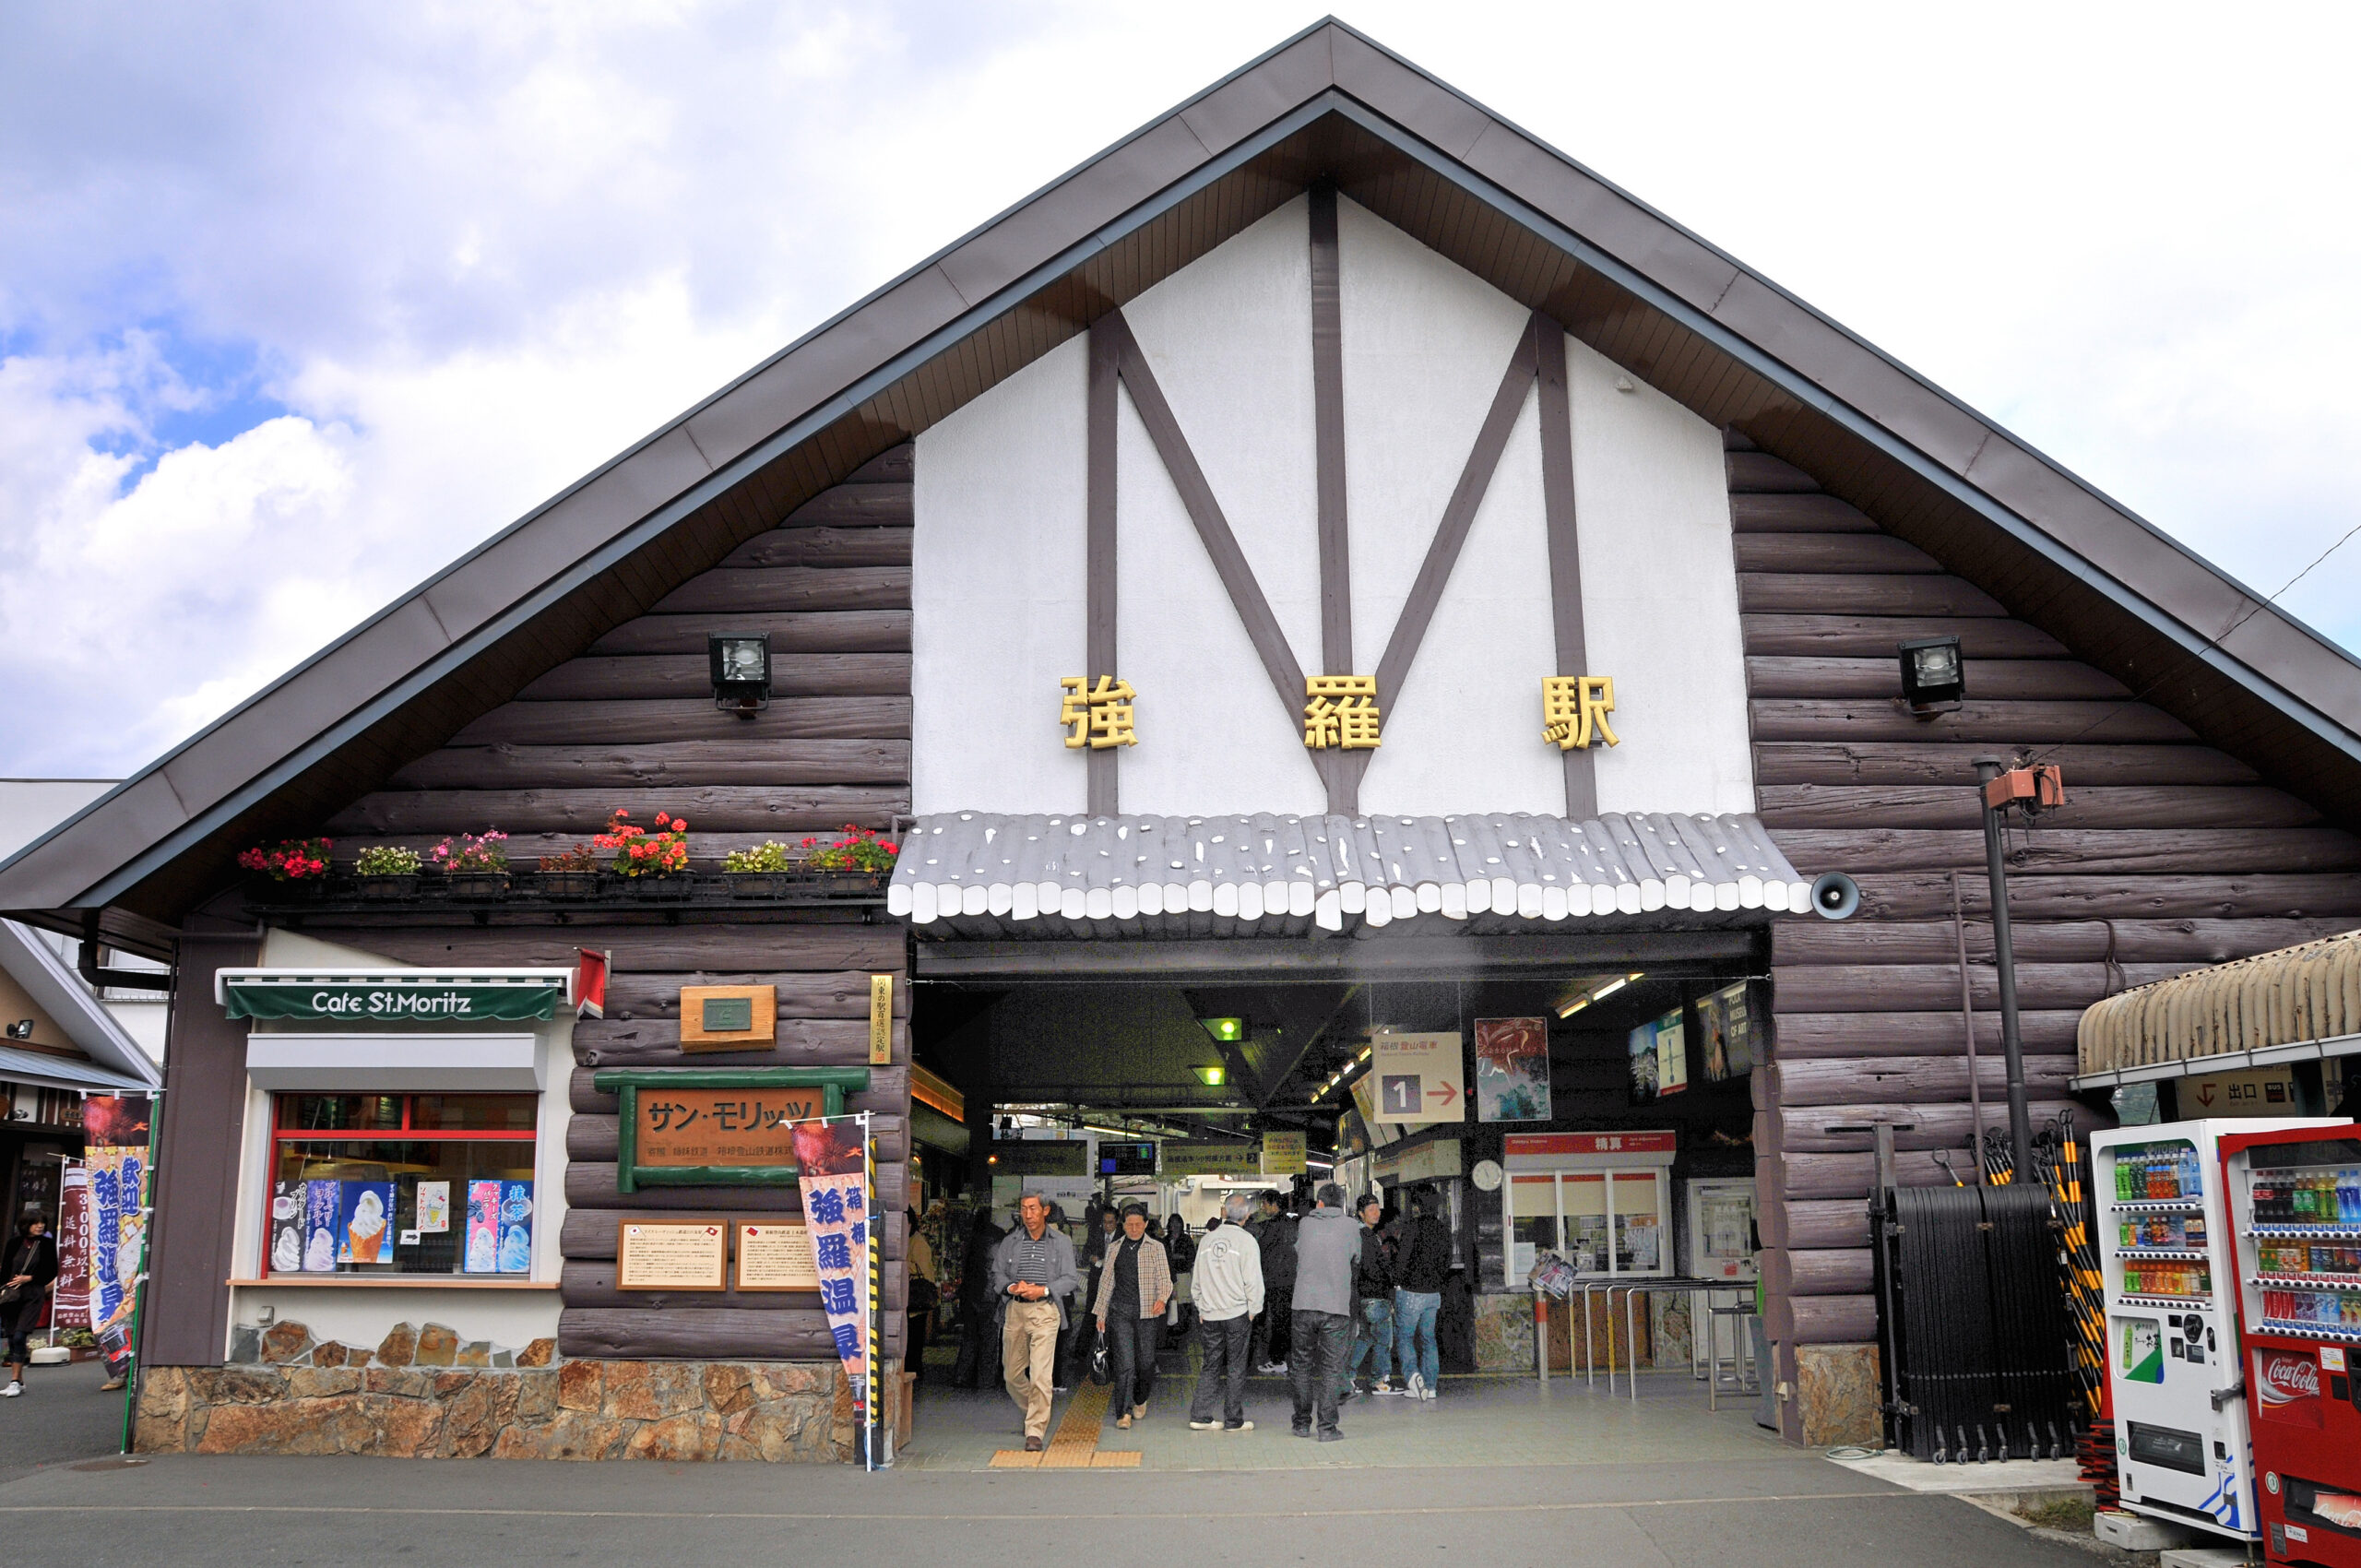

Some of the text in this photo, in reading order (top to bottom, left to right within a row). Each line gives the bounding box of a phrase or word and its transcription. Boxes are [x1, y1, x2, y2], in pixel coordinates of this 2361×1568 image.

[1061, 674, 1620, 750] 強羅駅
[312, 992, 362, 1014] Cafe
[1394, 1080, 1406, 1108] 1
[2228, 1083, 2257, 1100] 出口
[648, 1101, 813, 1133] サン・モリッツ
[1595, 1136, 1623, 1150] 精算
[297, 1182, 308, 1230] カスタード
[313, 1188, 325, 1228] ヨーグルト
[324, 1182, 337, 1228] ブルーベリー
[508, 1184, 526, 1222] 抹茶
[59, 1216, 77, 1288] 送料無料
[2268, 1358, 2319, 1391] Coca-Cola
